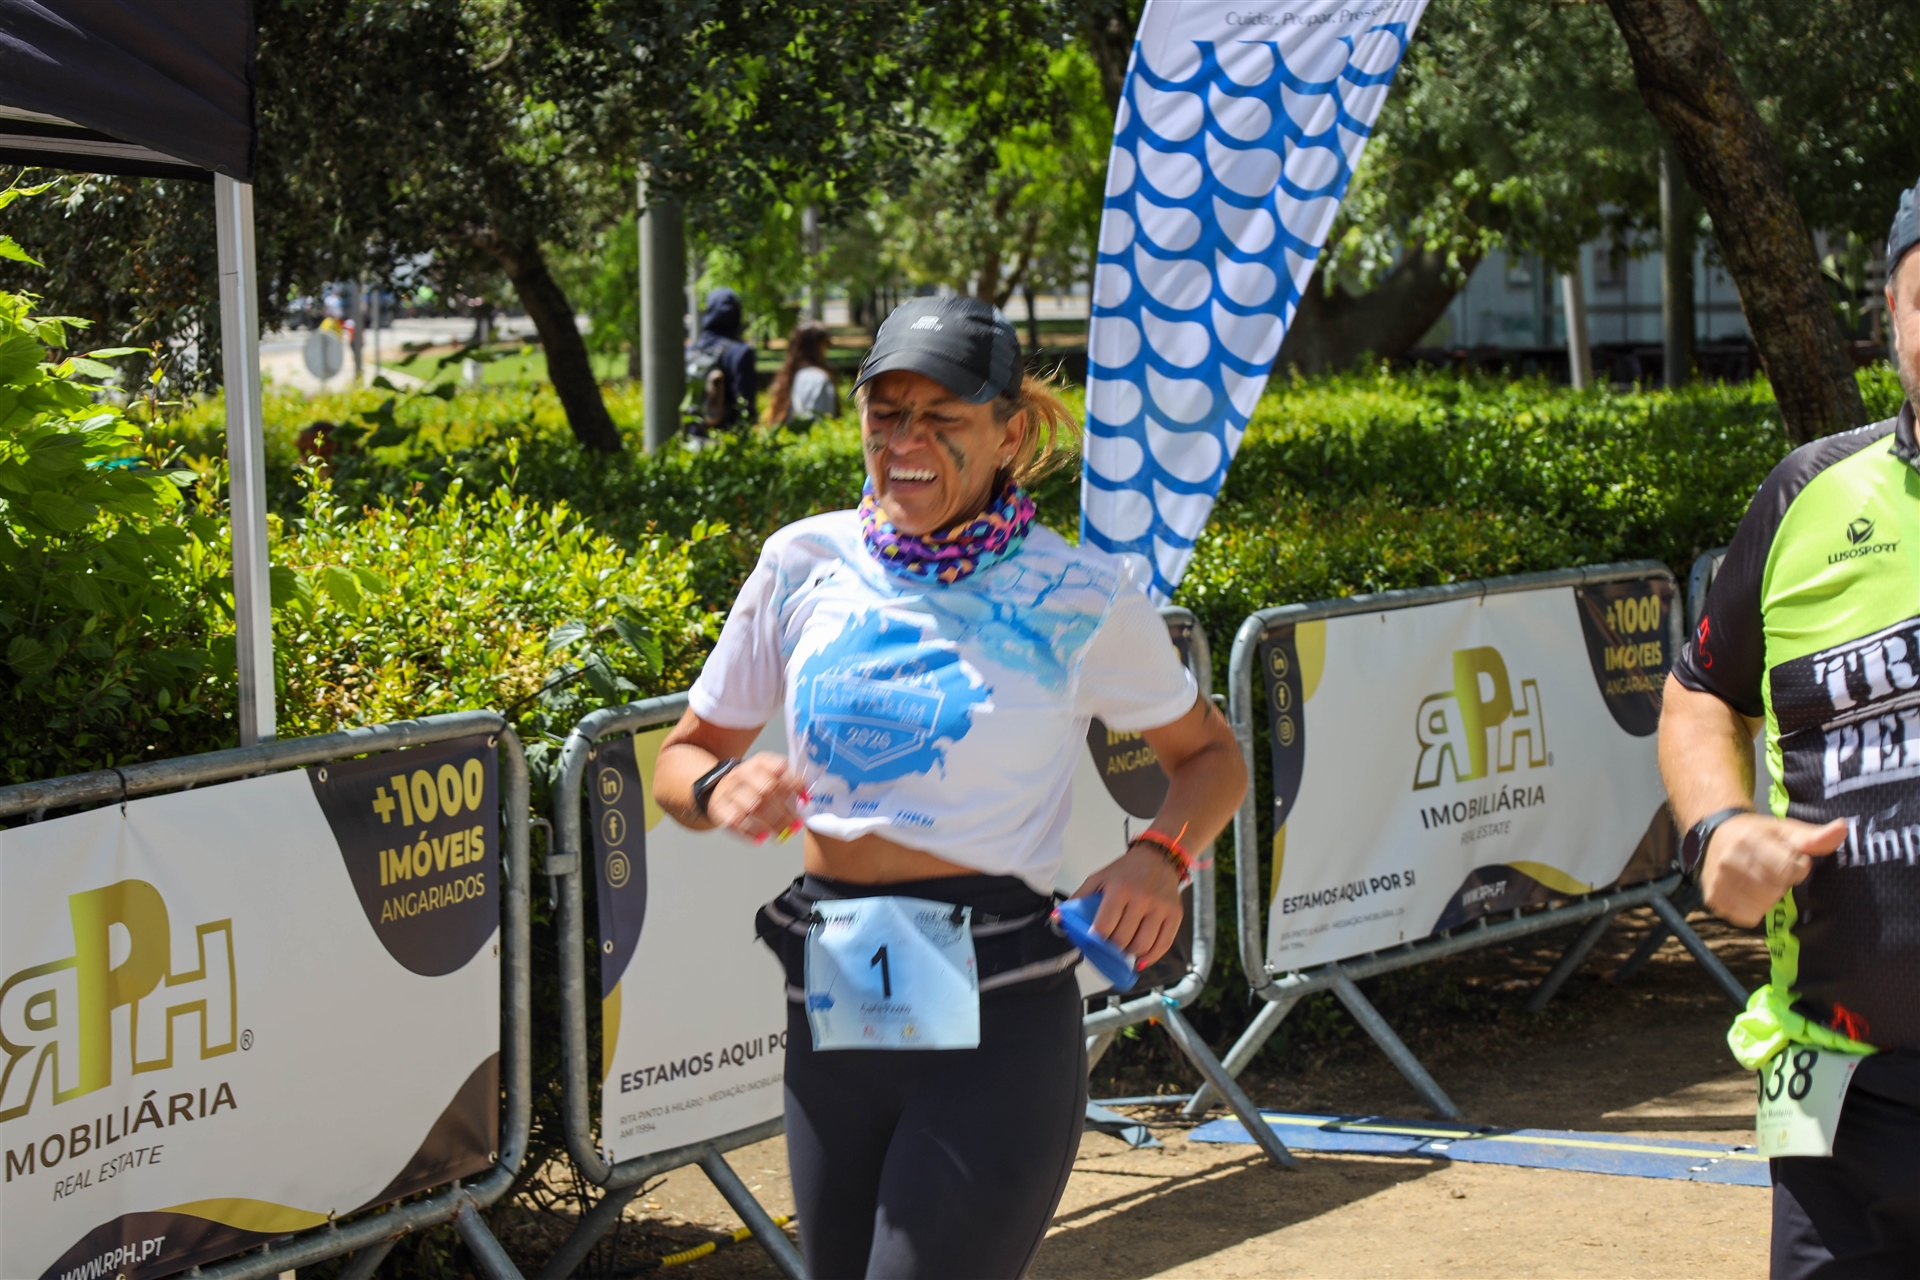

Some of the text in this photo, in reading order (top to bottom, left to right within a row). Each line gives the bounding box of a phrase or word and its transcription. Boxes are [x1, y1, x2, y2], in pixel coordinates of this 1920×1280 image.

[1827, 540, 1901, 565] LUSOSPORT
[1606, 594, 1660, 635] +1000
[1604, 638, 1663, 671] IMÓVEIS
[372, 757, 485, 827] +1000
[1420, 784, 1546, 829] IMOBILIÁRIA
[379, 826, 486, 886] IMÓVEIS
[380, 873, 486, 924] ANGARIADOS
[1282, 870, 1416, 915] ESTAMOS AQUI POR SI
[870, 943, 893, 1000] 1
[620, 1052, 713, 1094] ESTAMOS
[718, 1037, 764, 1069] AQUI
[5, 1081, 238, 1183] MOBILIÁRIA
[638, 1106, 663, 1121] PINTO
[53, 1144, 165, 1202] REAL ESTATE
